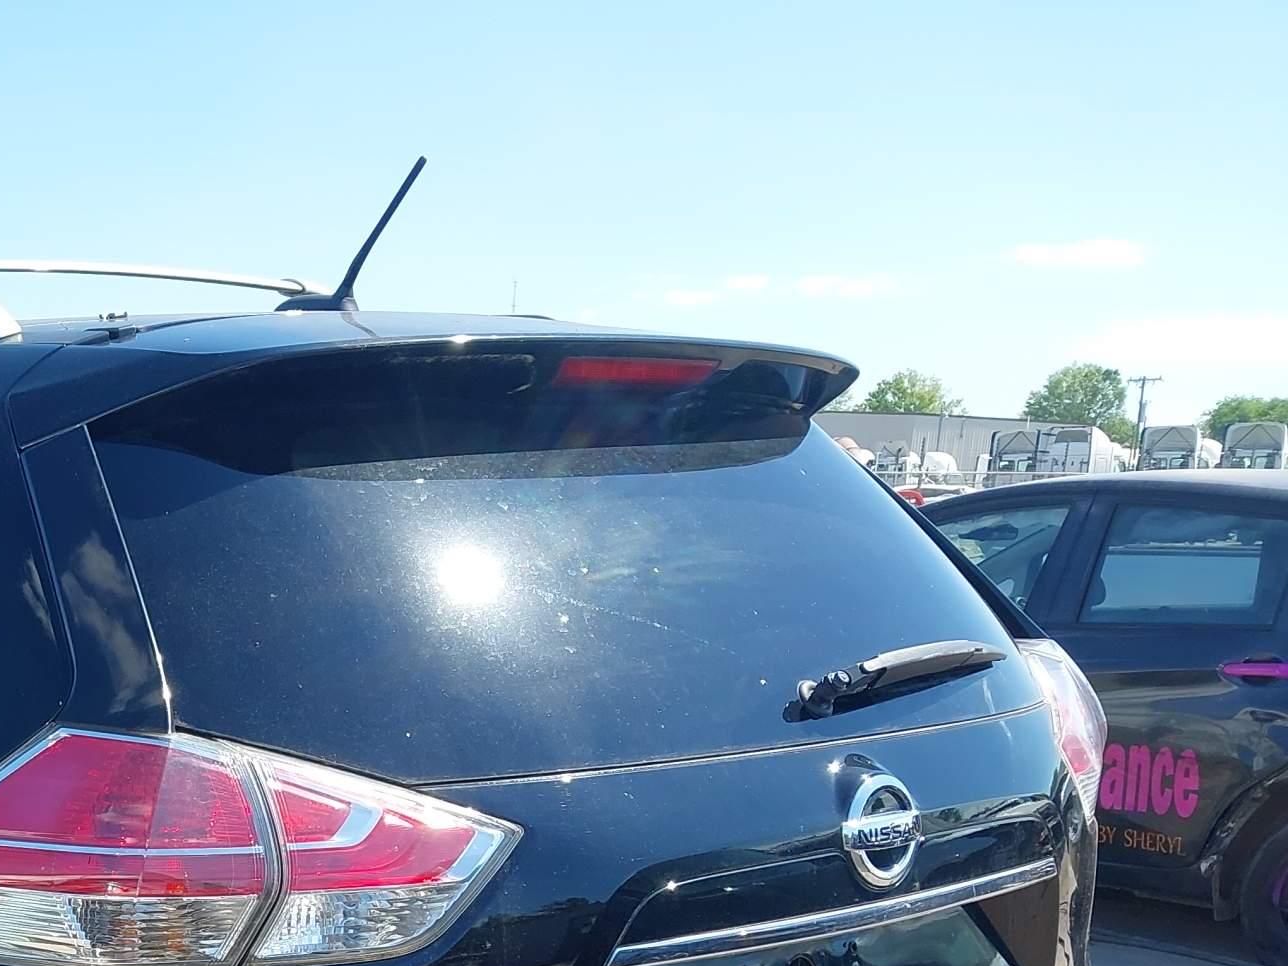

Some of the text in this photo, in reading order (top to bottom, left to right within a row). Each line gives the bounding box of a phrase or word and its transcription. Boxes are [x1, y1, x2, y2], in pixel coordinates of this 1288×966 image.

[857, 815, 921, 844] NISSAN
[1097, 825, 1187, 857] BY SHERYL
